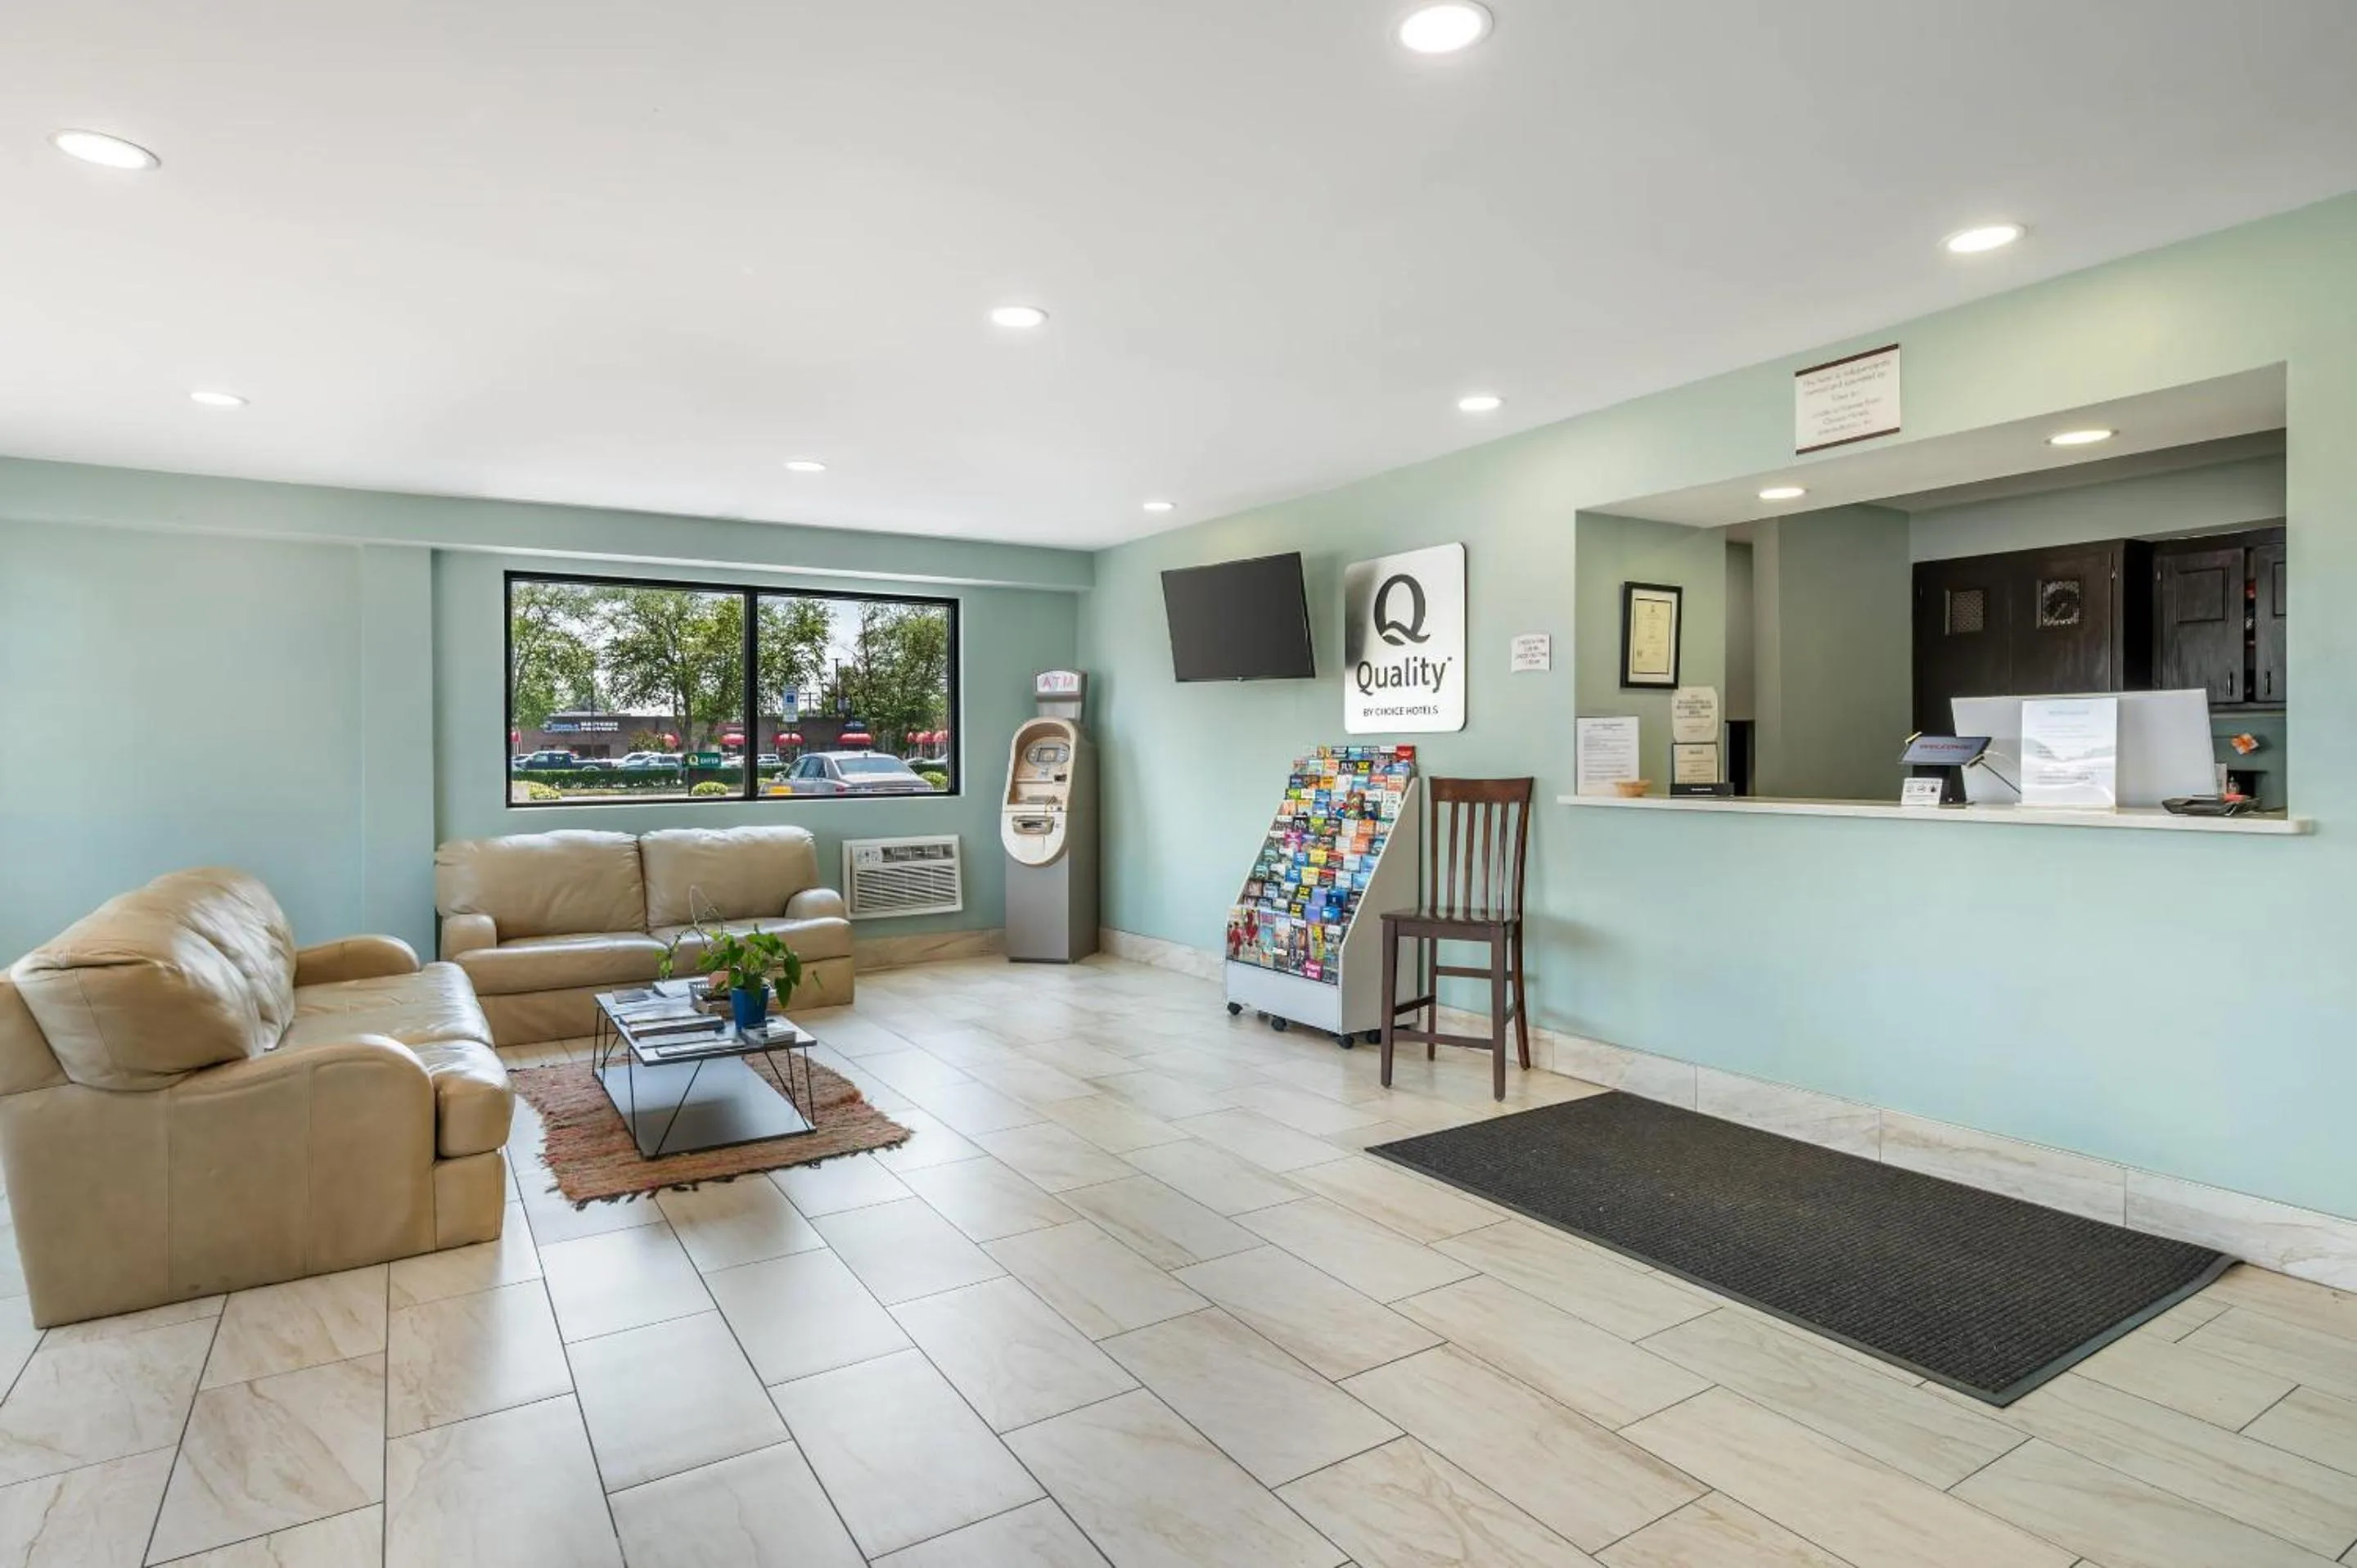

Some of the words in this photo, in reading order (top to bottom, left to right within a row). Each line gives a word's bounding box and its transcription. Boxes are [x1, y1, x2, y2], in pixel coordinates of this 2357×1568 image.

[1374, 574, 1431, 646] Q
[1043, 674, 1075, 689] ATM
[1357, 656, 1446, 696] Quality
[1363, 707, 1373, 717] BY
[1375, 706, 1404, 716] CHOICE
[1406, 705, 1439, 715] HOTELS
